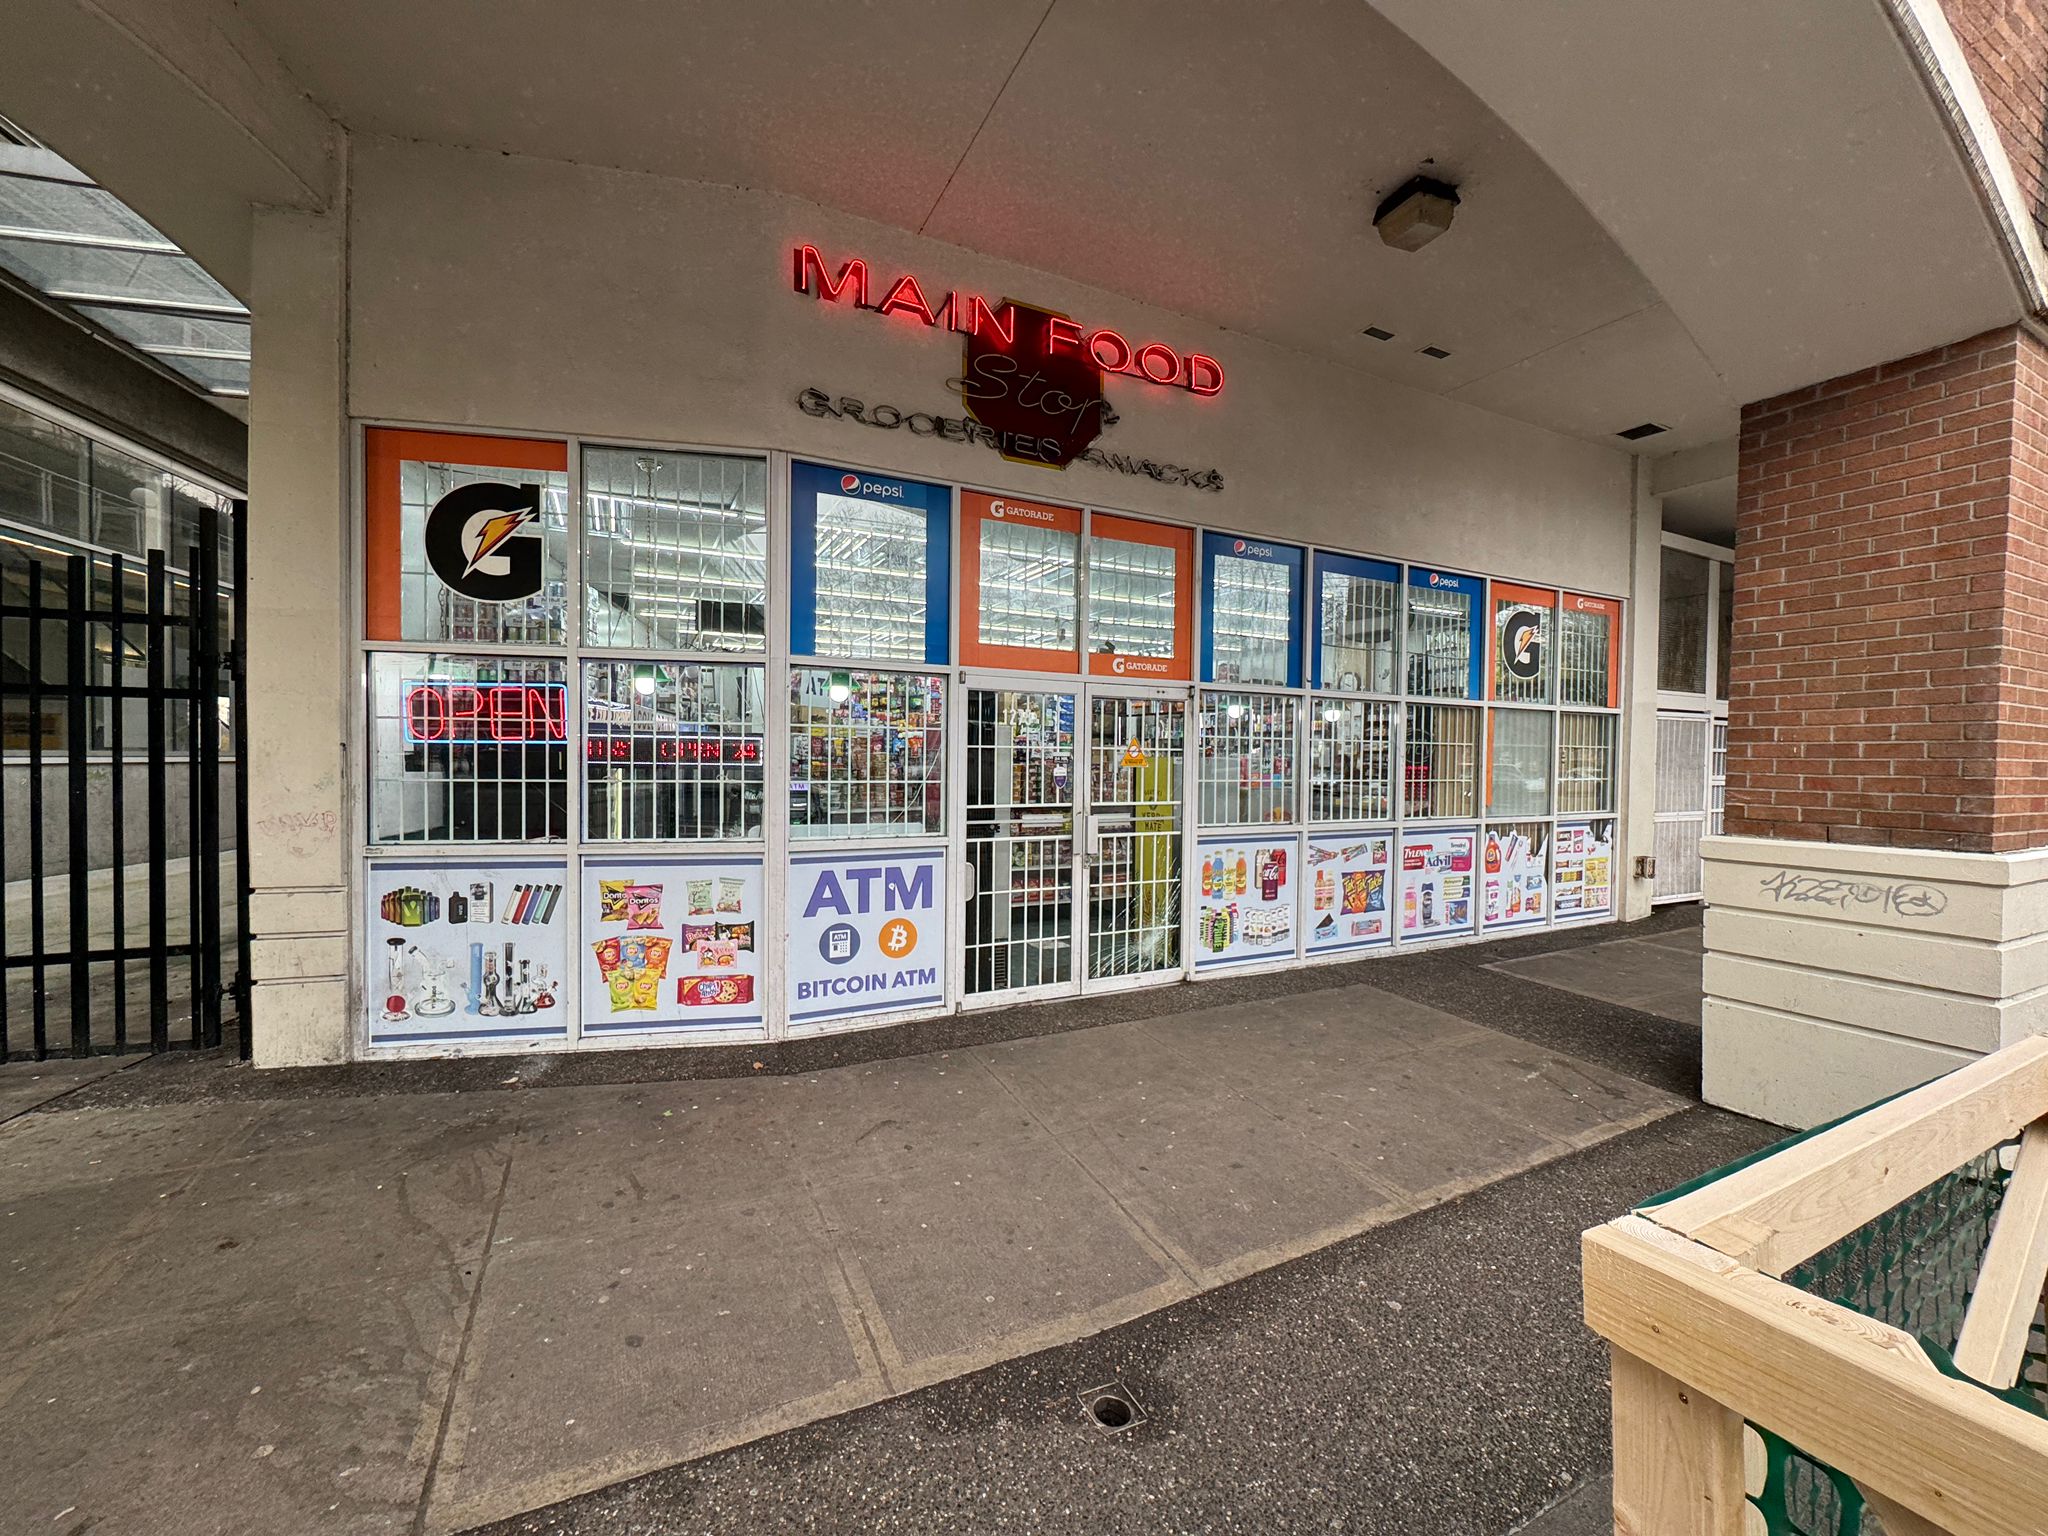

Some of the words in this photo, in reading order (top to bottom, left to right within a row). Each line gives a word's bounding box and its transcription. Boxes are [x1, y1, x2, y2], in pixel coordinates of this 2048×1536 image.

[794, 245, 1015, 344] MAIN
[1048, 317, 1225, 396] FOOD
[797, 387, 1062, 460] GROCERIES
[863, 481, 904, 499] pepsi
[1006, 505, 1055, 522] GATORADE
[1247, 543, 1273, 558] pepsi
[1439, 576, 1459, 589] pepsi
[1126, 661, 1168, 674] GATORADE
[806, 676, 829, 696] AT
[406, 686, 565, 740] OPEN
[1426, 855, 1451, 867] Advil
[801, 865, 934, 918] ATM
[798, 973, 887, 1000] BITCOIN
[891, 967, 936, 989] ATM
